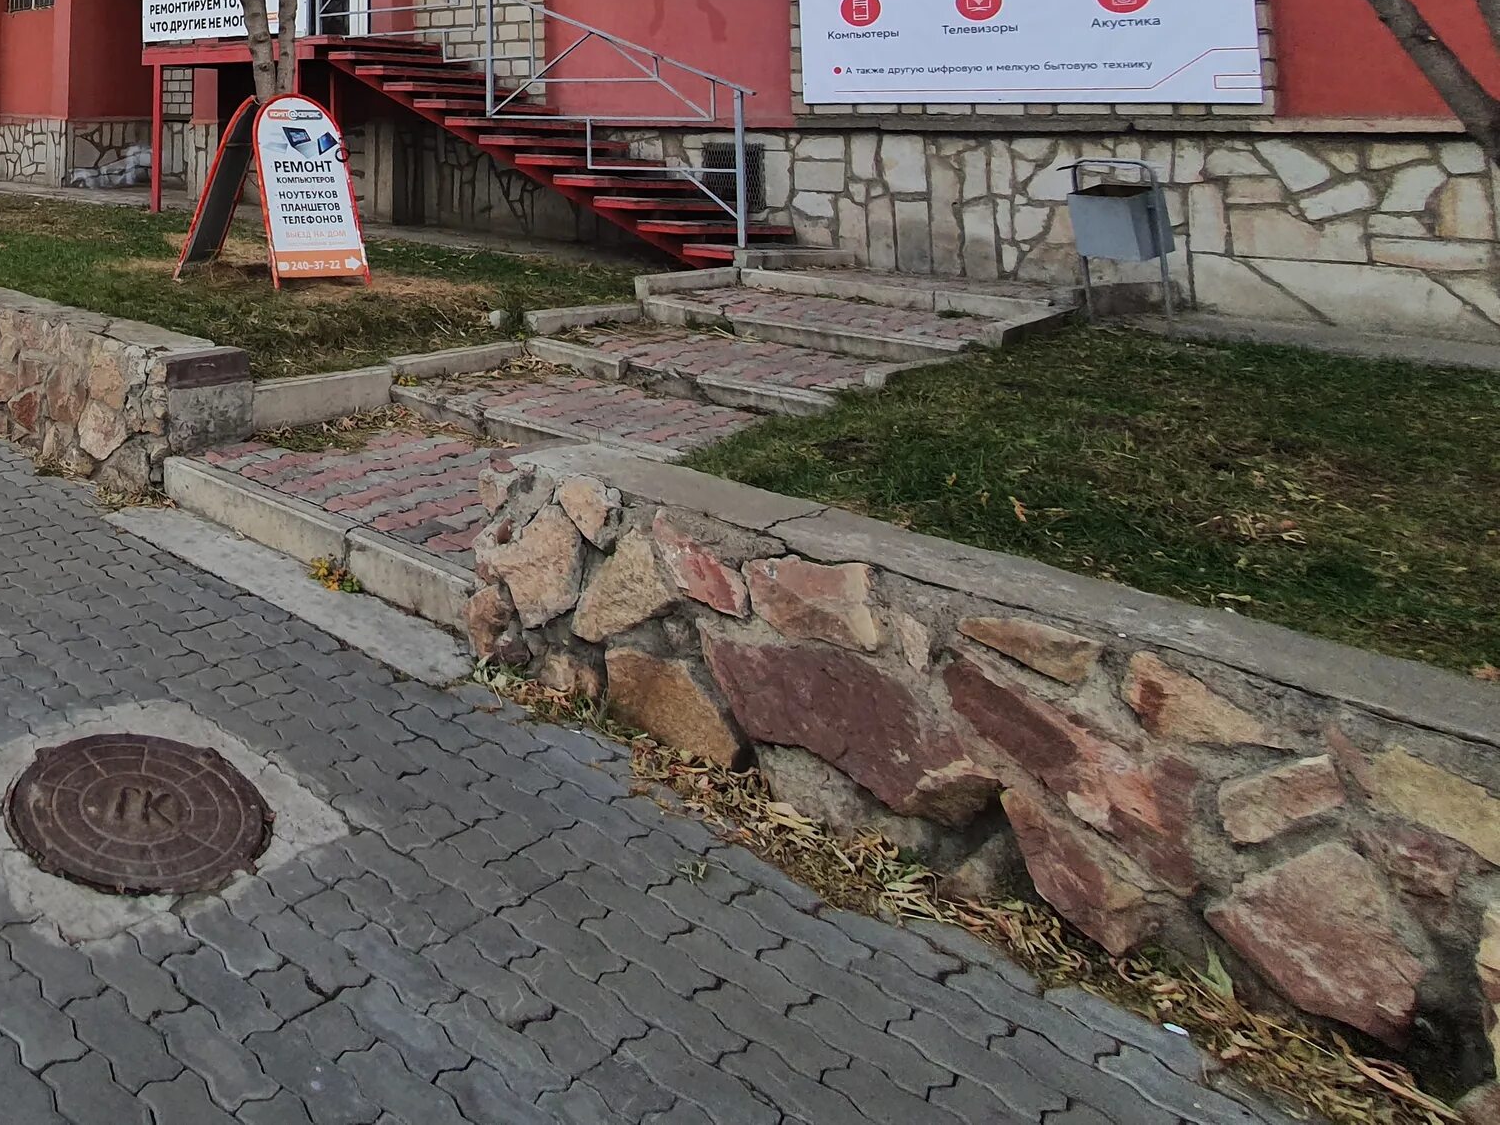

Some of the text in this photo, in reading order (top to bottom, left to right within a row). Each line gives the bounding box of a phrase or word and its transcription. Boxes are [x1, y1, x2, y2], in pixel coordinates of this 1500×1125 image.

[150, 15, 244, 34] ЧТО ДРУГИЕ НЕ МОГ
[1091, 17, 1161, 30] Акустика
[827, 30, 899, 40] Компьютеры
[941, 24, 1019, 36] Телевизоры
[845, 66, 853, 74] А
[856, 66, 885, 74] также
[887, 66, 925, 76] другую
[927, 64, 983, 75] цифровую
[996, 63, 1040, 73] мелкую
[1043, 60, 1098, 71] бытовую
[1102, 60, 1153, 70] технику
[274, 160, 332, 173] РЕМОНТ
[276, 176, 335, 184] КОМПЬЮТЕРОВ
[279, 190, 338, 200] НОУТБУКОВ
[281, 203, 341, 212] ПЛАНШЕТОВ
[283, 215, 343, 224] ТЕЛЕФОНОВ
[313, 230, 325, 238] НА
[327, 229, 347, 239] ДОМ
